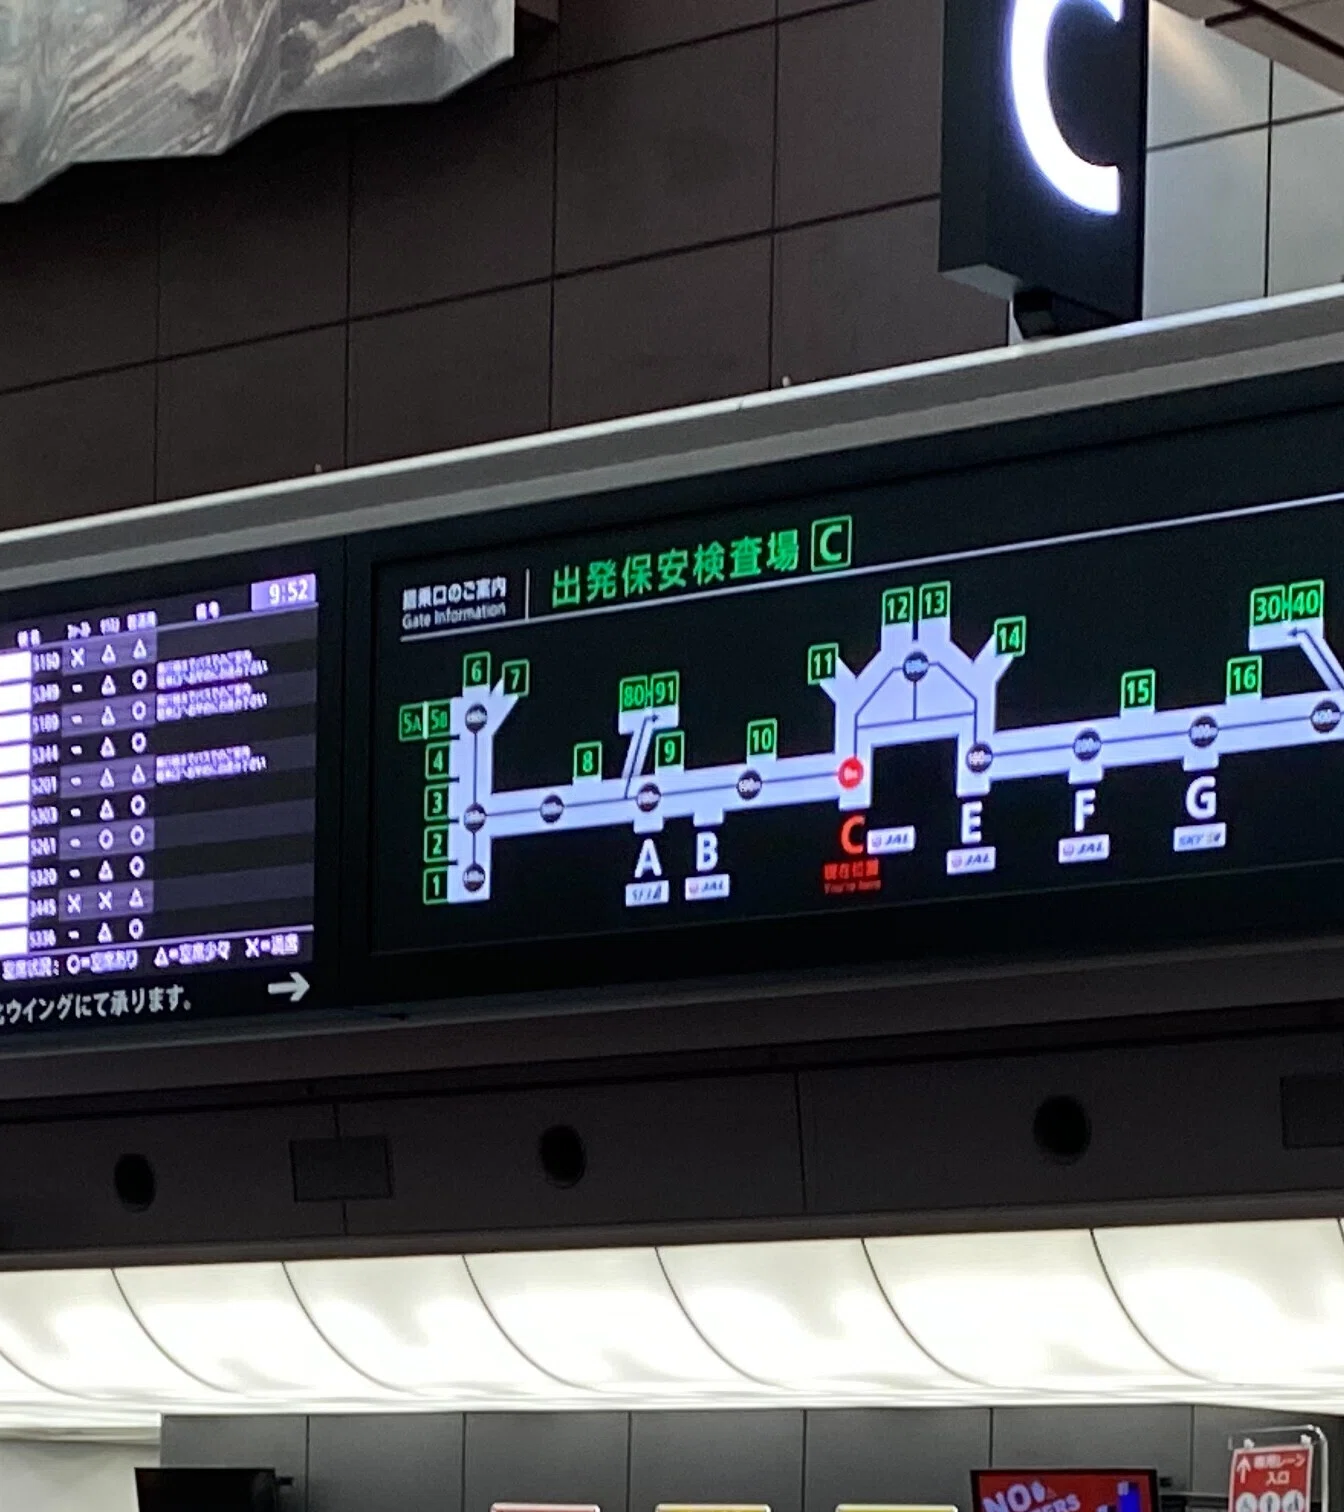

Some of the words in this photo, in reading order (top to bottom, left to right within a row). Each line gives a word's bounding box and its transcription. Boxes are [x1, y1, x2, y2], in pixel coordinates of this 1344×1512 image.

[552, 529, 798, 608] 出発保安検査場
[819, 524, 842, 563] C
[268, 579, 309, 606] 9:52
[923, 589, 946, 616] 13
[1293, 589, 1321, 615] 40
[402, 611, 432, 630] Gate
[434, 602, 507, 627] Information
[886, 595, 908, 622] 12
[1255, 595, 1281, 621] 30
[999, 625, 1020, 651] 14
[813, 651, 833, 677] 11
[1232, 664, 1257, 691] 16
[622, 684, 646, 707] 80
[655, 680, 675, 704] 91
[1126, 677, 1150, 705] 15
[751, 729, 773, 753] 10
[1074, 787, 1097, 833] F
[1184, 775, 1217, 820] G
[841, 814, 866, 855] C
[961, 800, 984, 845] E
[634, 837, 662, 878] A
[695, 831, 719, 872] B
